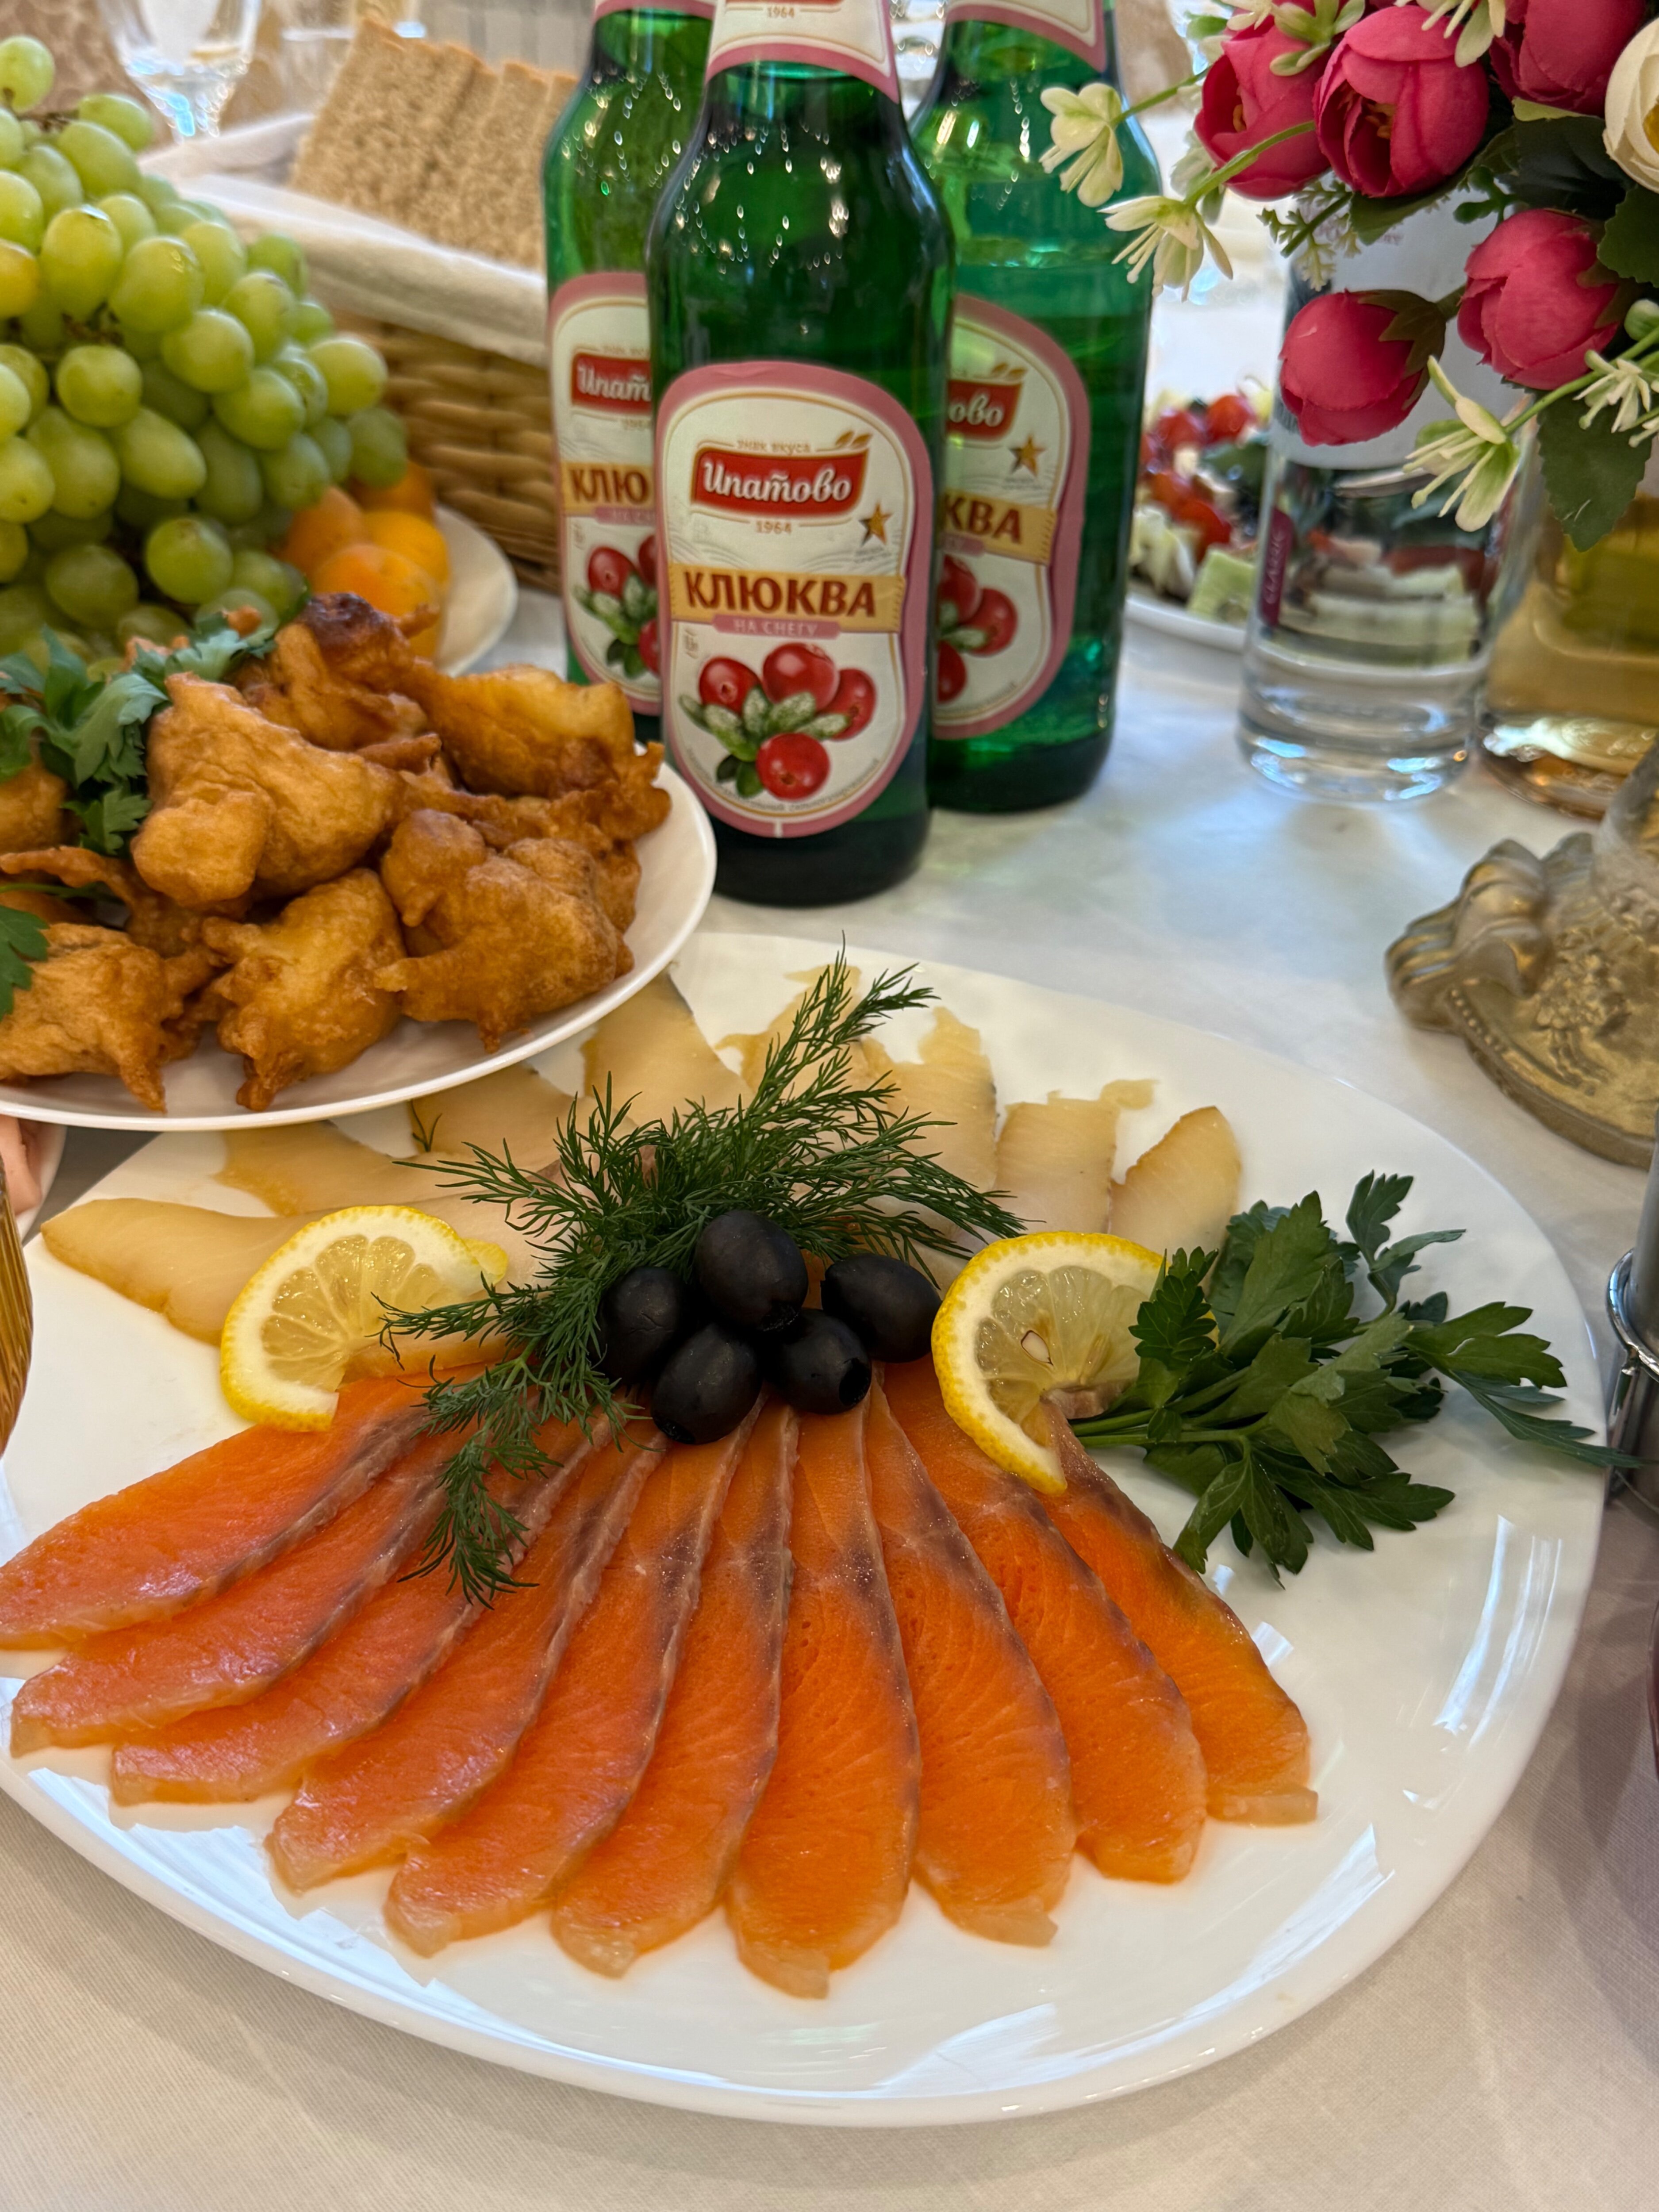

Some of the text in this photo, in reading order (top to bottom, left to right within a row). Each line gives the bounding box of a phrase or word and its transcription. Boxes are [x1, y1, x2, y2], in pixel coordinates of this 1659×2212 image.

[577, 365, 651, 401] Ипат
[570, 469, 649, 504] КЛЮ
[703, 461, 852, 503] Ипатово
[756, 520, 792, 534] 1964
[944, 495, 1022, 545] КВА
[684, 570, 877, 618] КЛЮКВА
[733, 618, 818, 636] НА СНЕГУ
